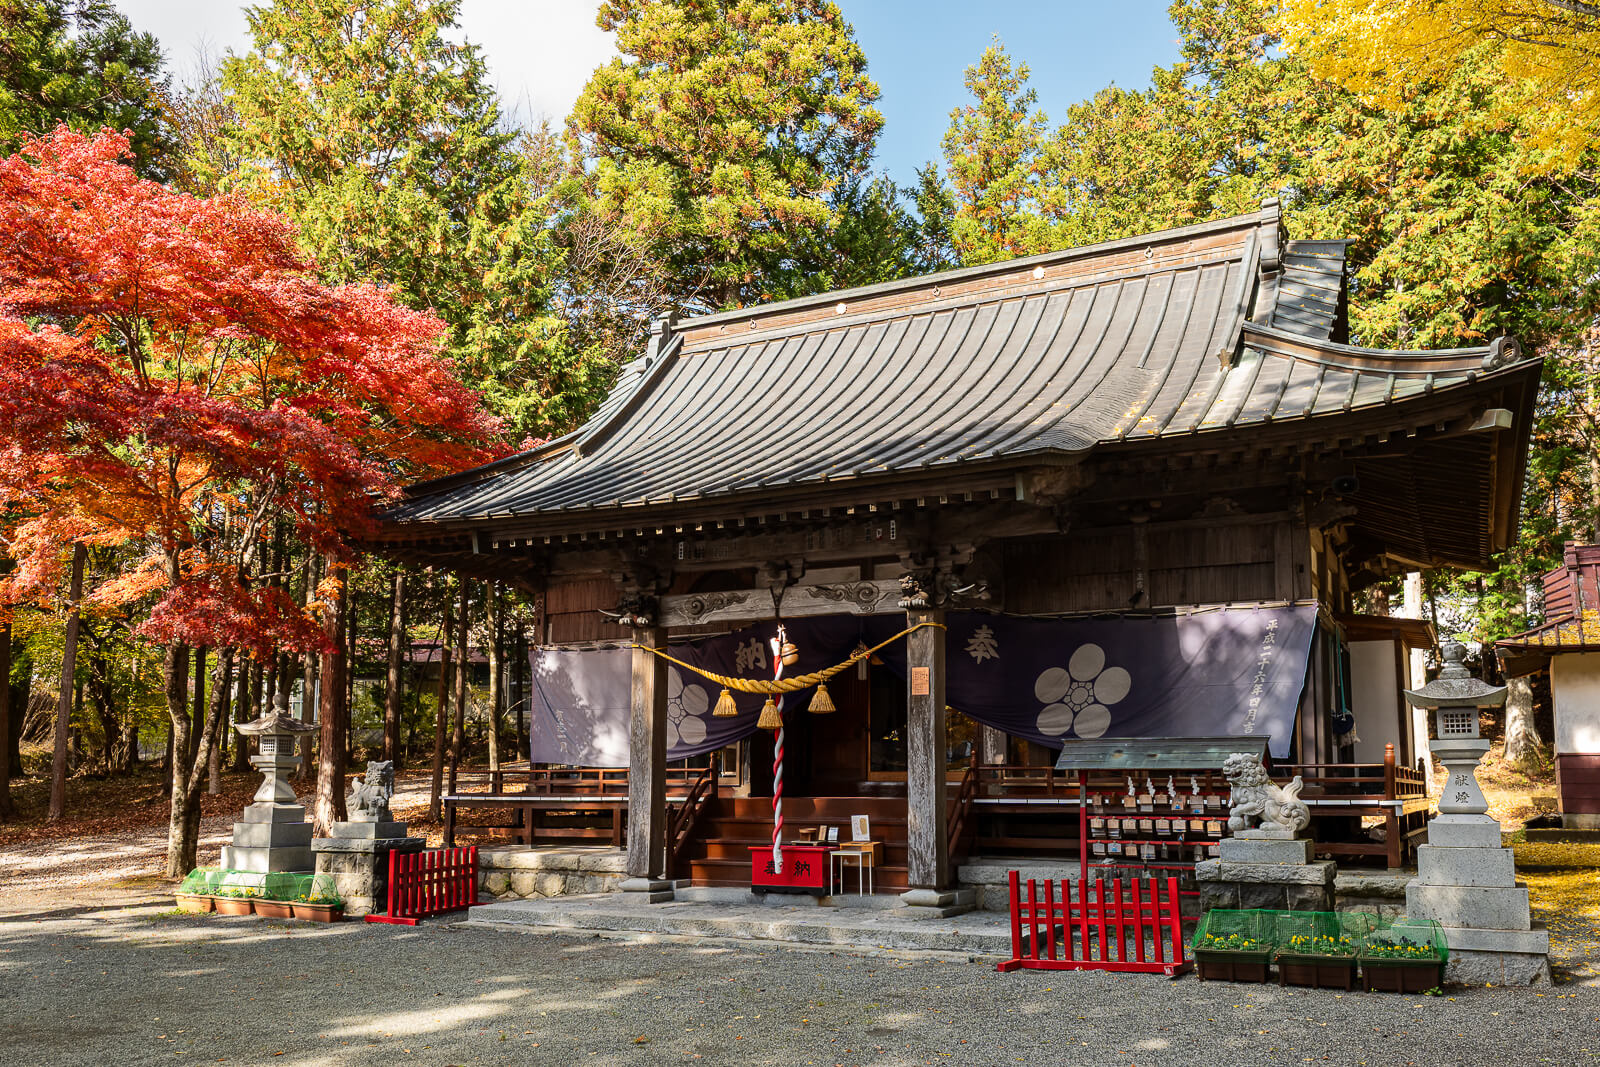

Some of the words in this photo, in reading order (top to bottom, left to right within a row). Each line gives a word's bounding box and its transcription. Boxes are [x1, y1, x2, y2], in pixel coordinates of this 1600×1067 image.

[734, 637, 767, 674] 納
[963, 623, 1001, 665] 奉
[1242, 618, 1279, 735] 平成二十六年四月吉
